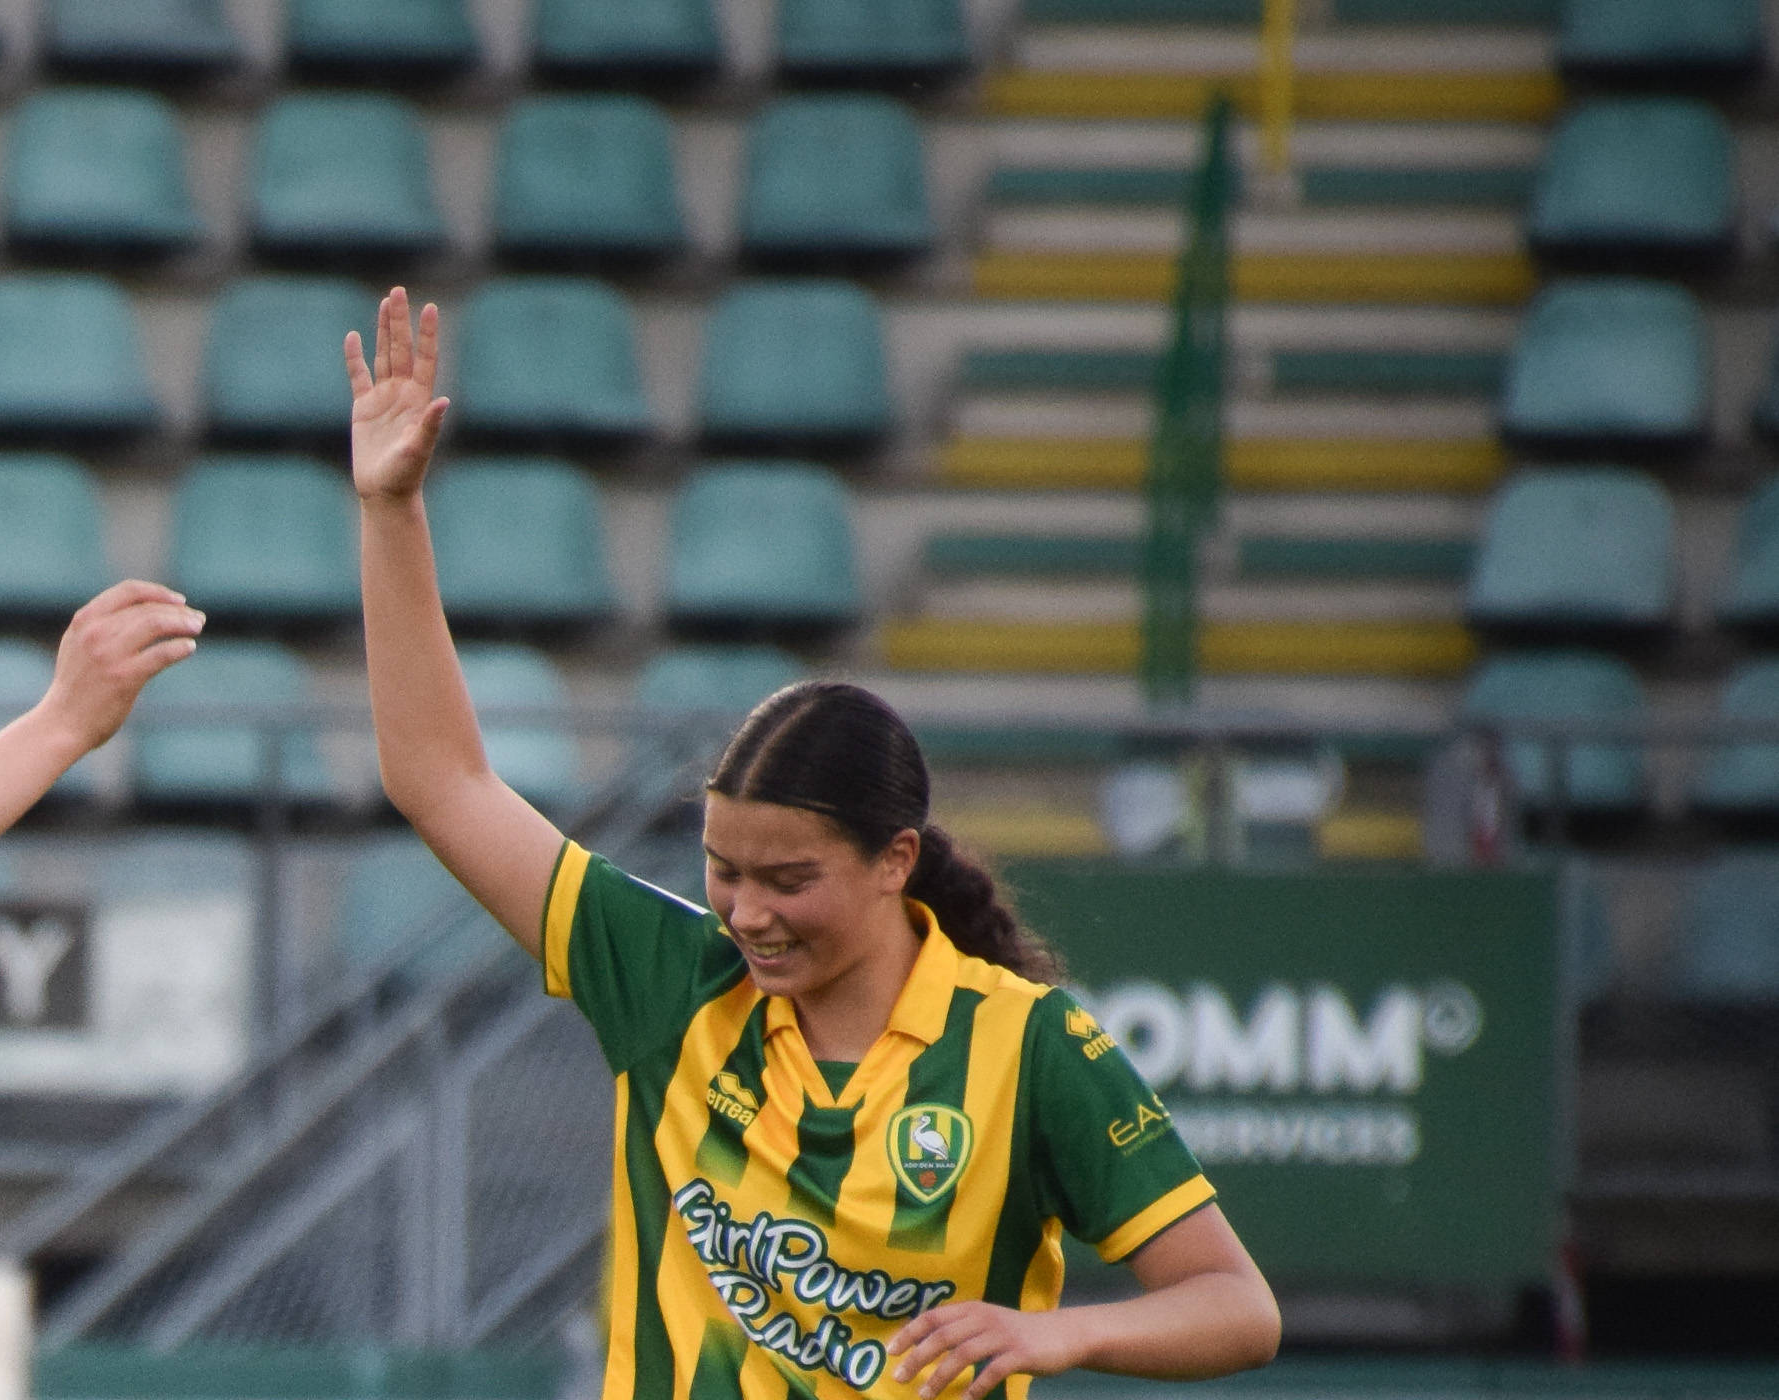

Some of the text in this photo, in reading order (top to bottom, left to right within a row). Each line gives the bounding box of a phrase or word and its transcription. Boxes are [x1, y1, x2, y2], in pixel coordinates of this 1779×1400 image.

[1068, 978, 1421, 1094] OMM
[707, 1088, 755, 1127] errea
[708, 1271, 886, 1391] Radio
